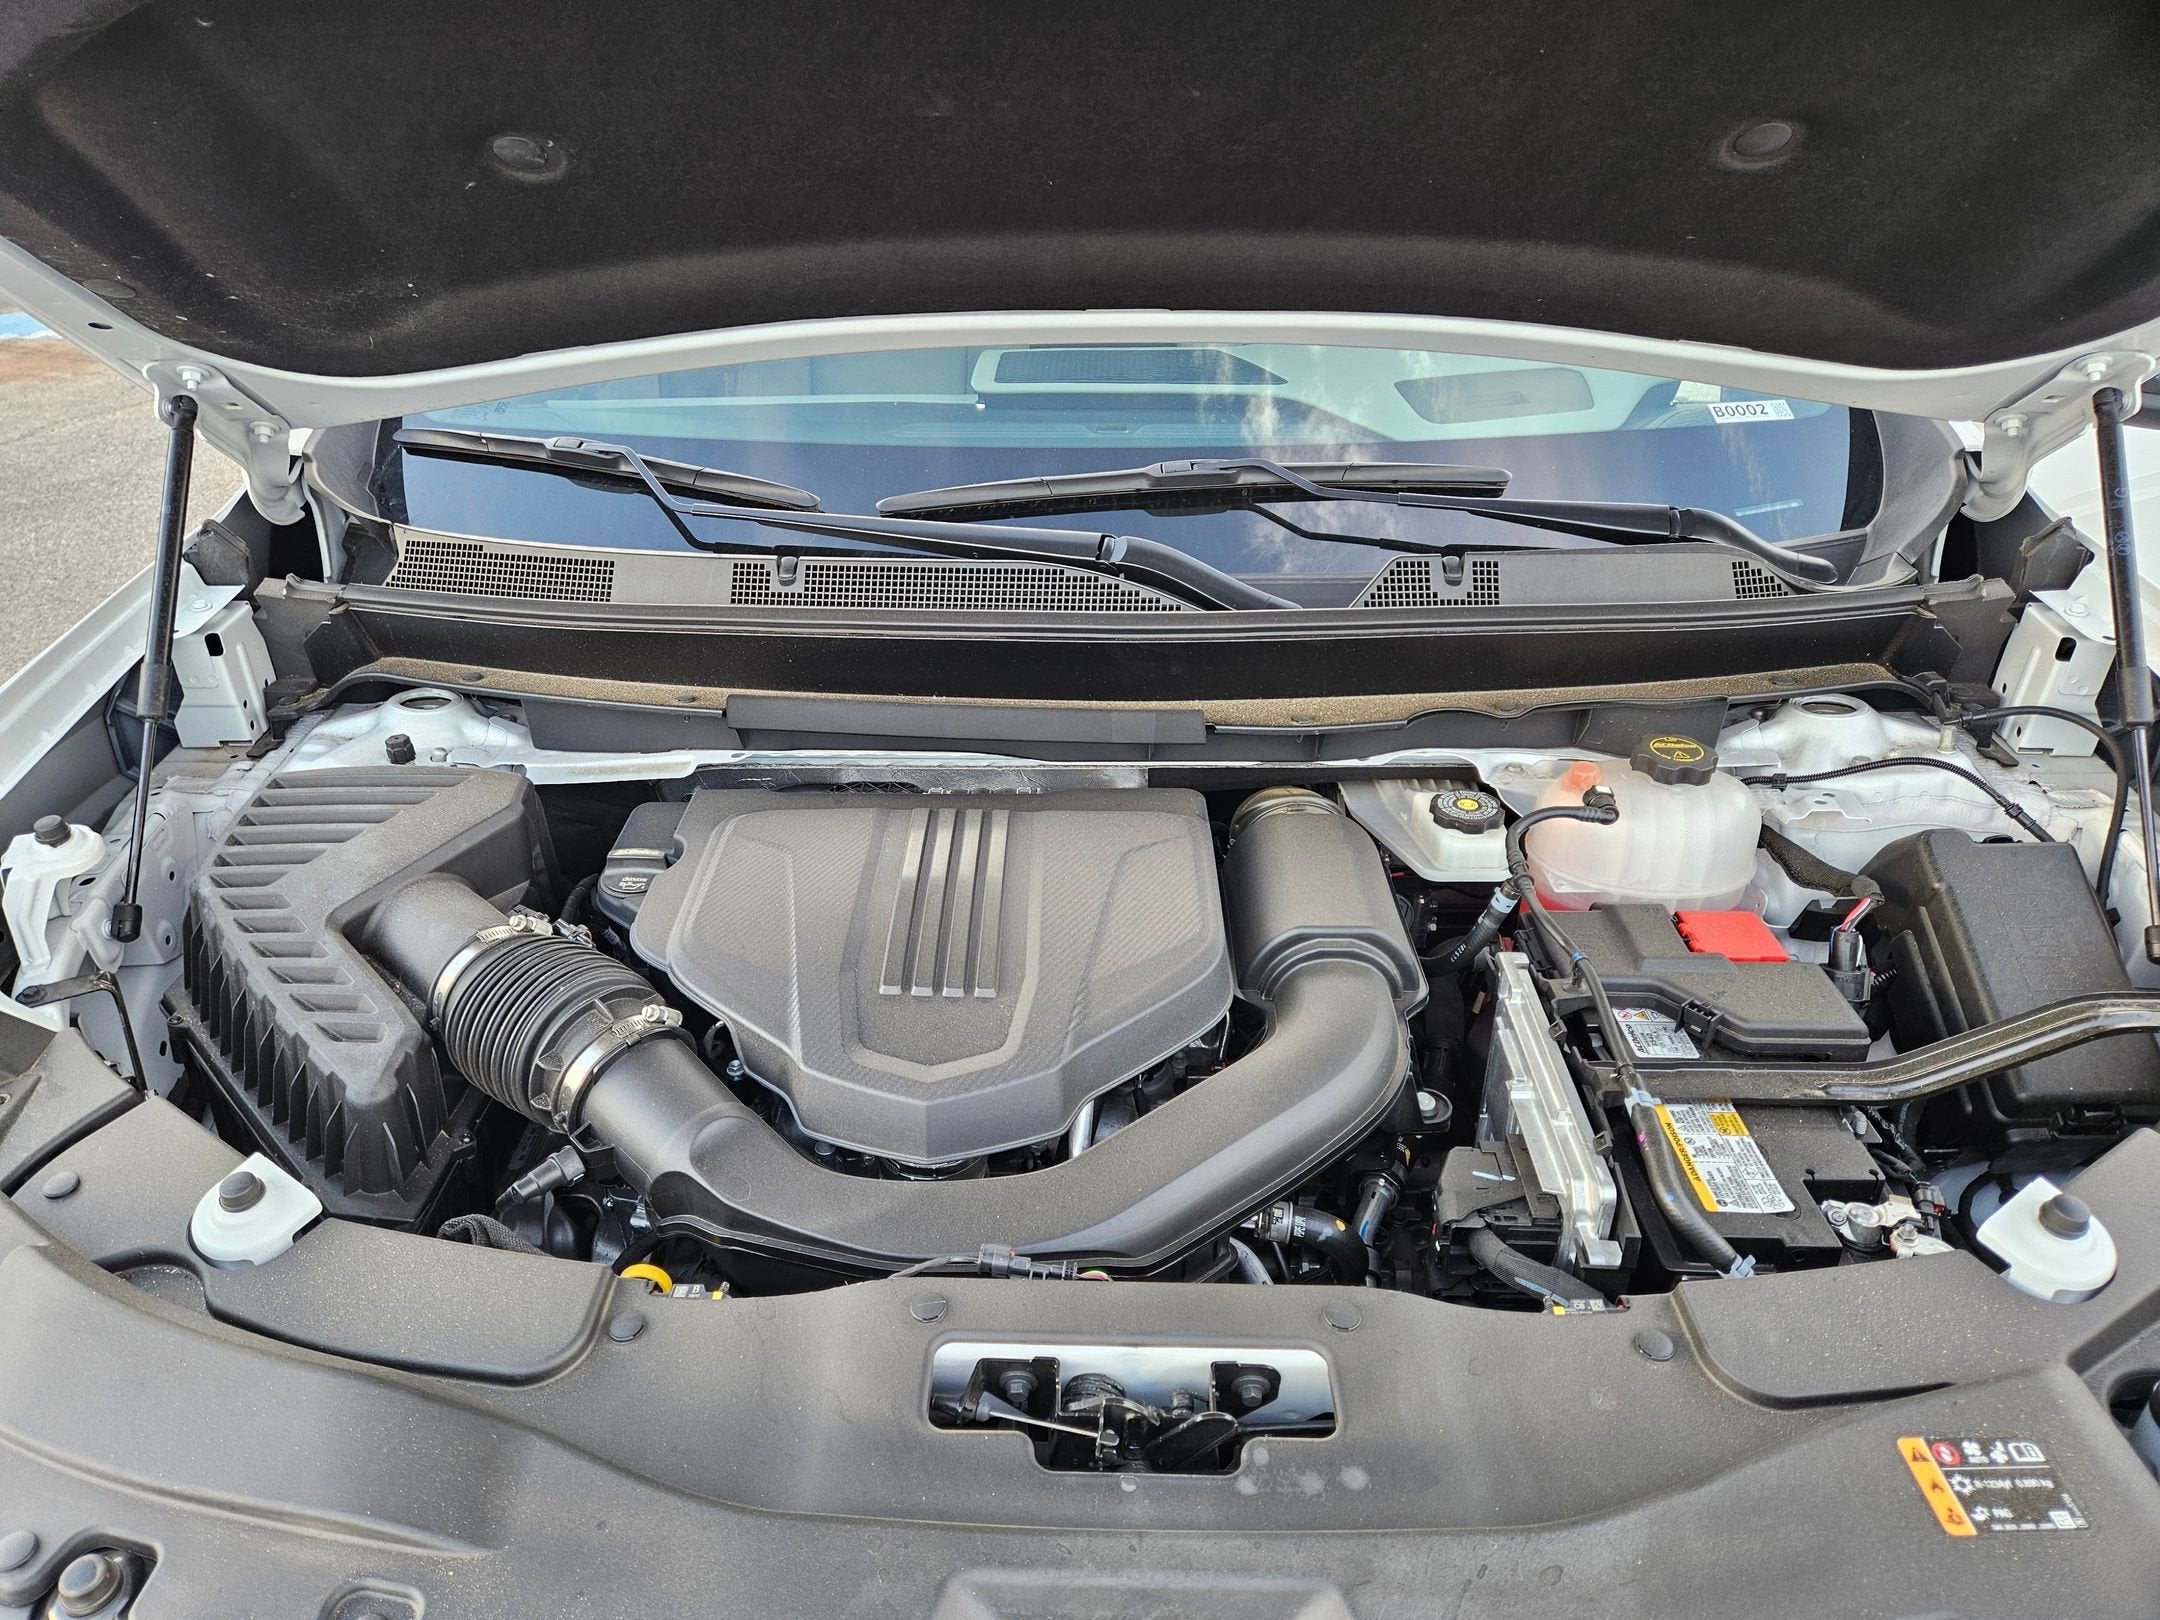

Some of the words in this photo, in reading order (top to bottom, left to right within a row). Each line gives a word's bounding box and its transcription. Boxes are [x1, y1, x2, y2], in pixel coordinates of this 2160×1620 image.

[1712, 403, 1769, 418] B0002
[1625, 1023, 1646, 1054] ACDelco
[1664, 1122, 1683, 1147] POISON
